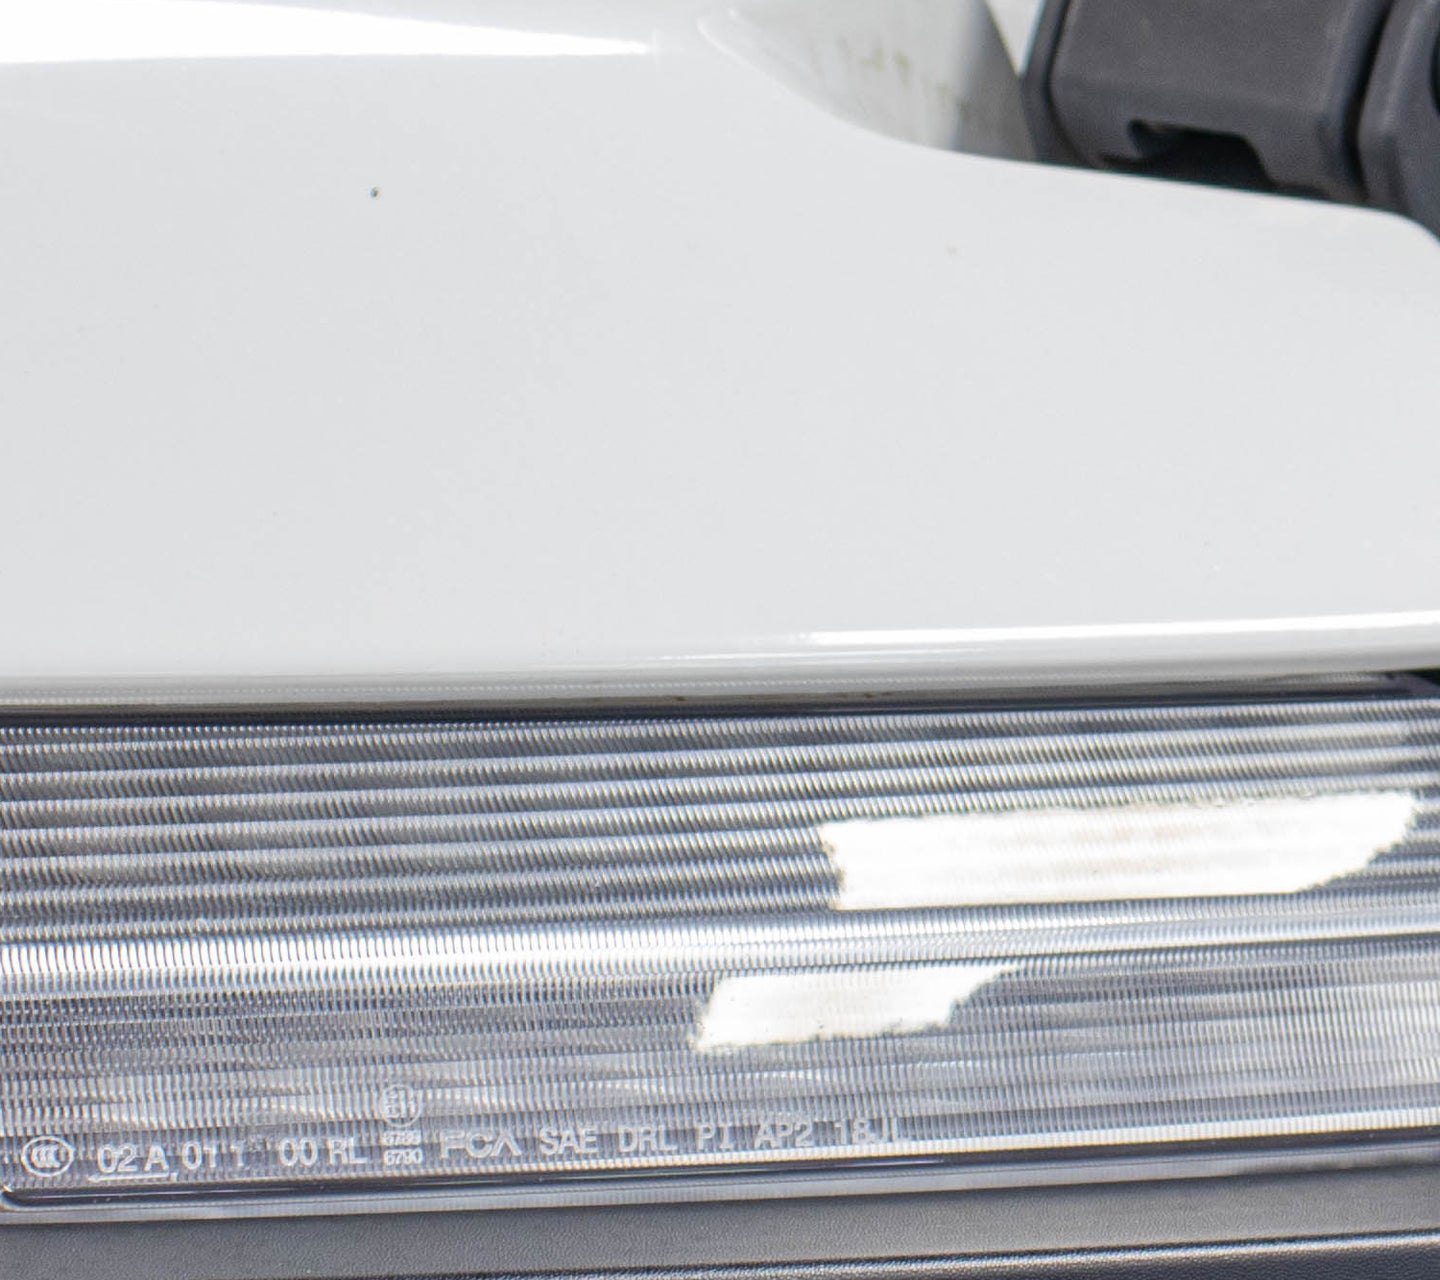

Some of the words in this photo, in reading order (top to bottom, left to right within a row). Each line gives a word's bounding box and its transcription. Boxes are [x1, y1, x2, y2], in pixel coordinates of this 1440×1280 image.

[440, 1128, 523, 1159] FCA
[538, 1125, 599, 1155] SAE
[618, 1124, 677, 1153] DRL
[754, 1118, 814, 1149] AP2
[96, 1143, 138, 1173] 02
[144, 1143, 170, 1172] A
